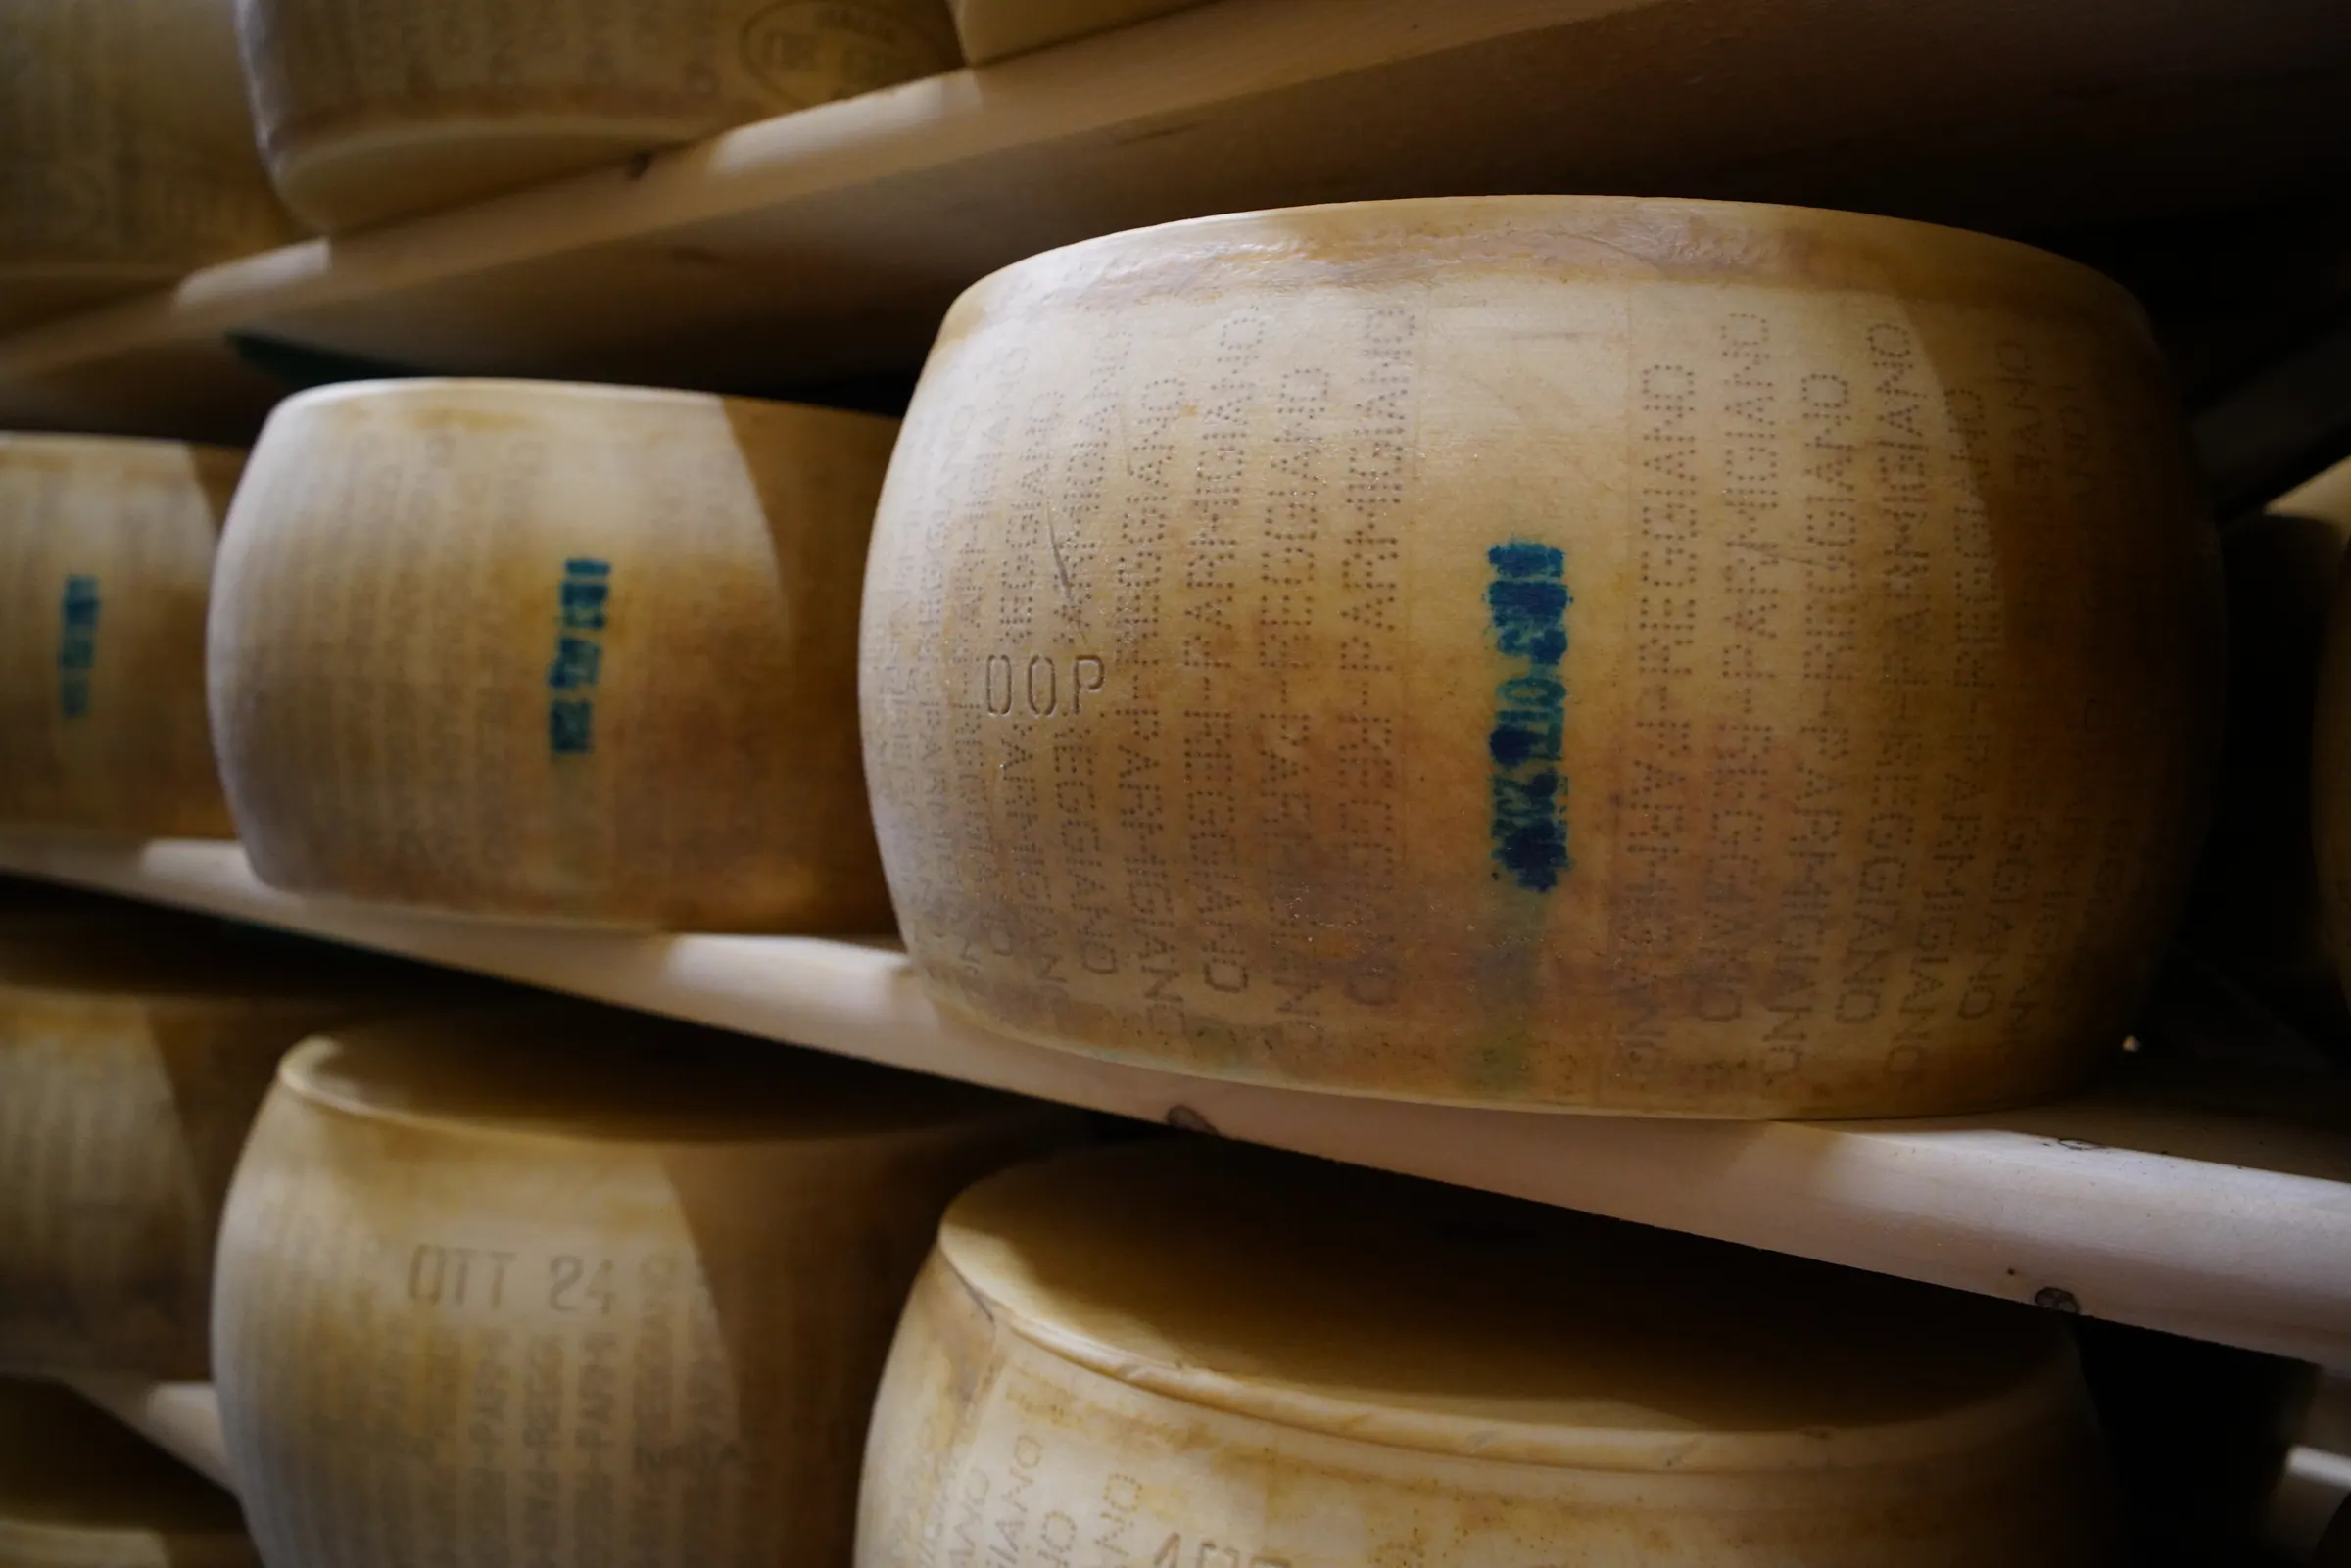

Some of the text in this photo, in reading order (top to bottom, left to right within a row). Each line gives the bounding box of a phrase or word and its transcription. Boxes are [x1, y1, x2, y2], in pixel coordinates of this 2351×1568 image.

[1114, 378, 1185, 665] REGGIANO
[1182, 317, 1267, 667] PARMIGIANO
[1260, 367, 1330, 669] REGGIANO
[1339, 306, 1415, 672] PARMIGIANO
[1638, 363, 1697, 677] REGGIANO
[1720, 312, 1780, 680] PARMIGIANO
[1799, 373, 1857, 682] REGGIANO
[985, 653, 1106, 717] DOP
[1115, 708, 1184, 1045] PARMIGIANO
[1183, 709, 1250, 995] REGGIANO
[1759, 726, 1852, 1074] PARMIGIANO
[1834, 732, 1922, 1025] REGGIANO
[408, 1243, 616, 1314] OTT 24
